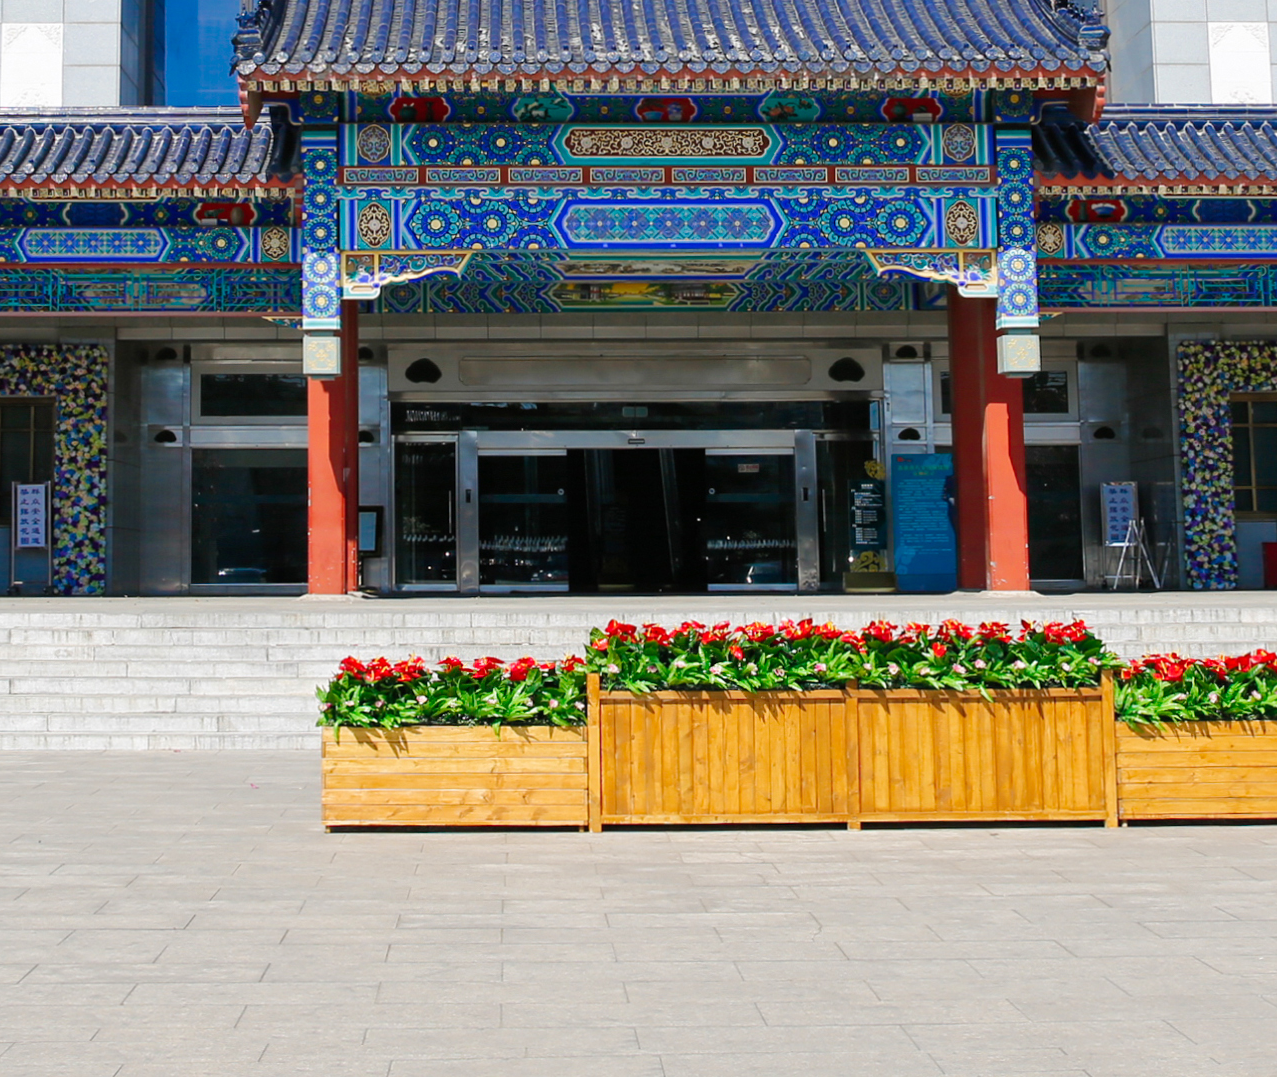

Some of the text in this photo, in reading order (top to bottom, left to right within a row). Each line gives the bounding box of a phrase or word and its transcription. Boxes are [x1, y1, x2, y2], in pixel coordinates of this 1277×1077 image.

[20, 488, 30, 544] 禁止摆放花圈
[31, 488, 41, 544] 群众安全通道
[1108, 488, 1118, 540] 禁止摆放花圈
